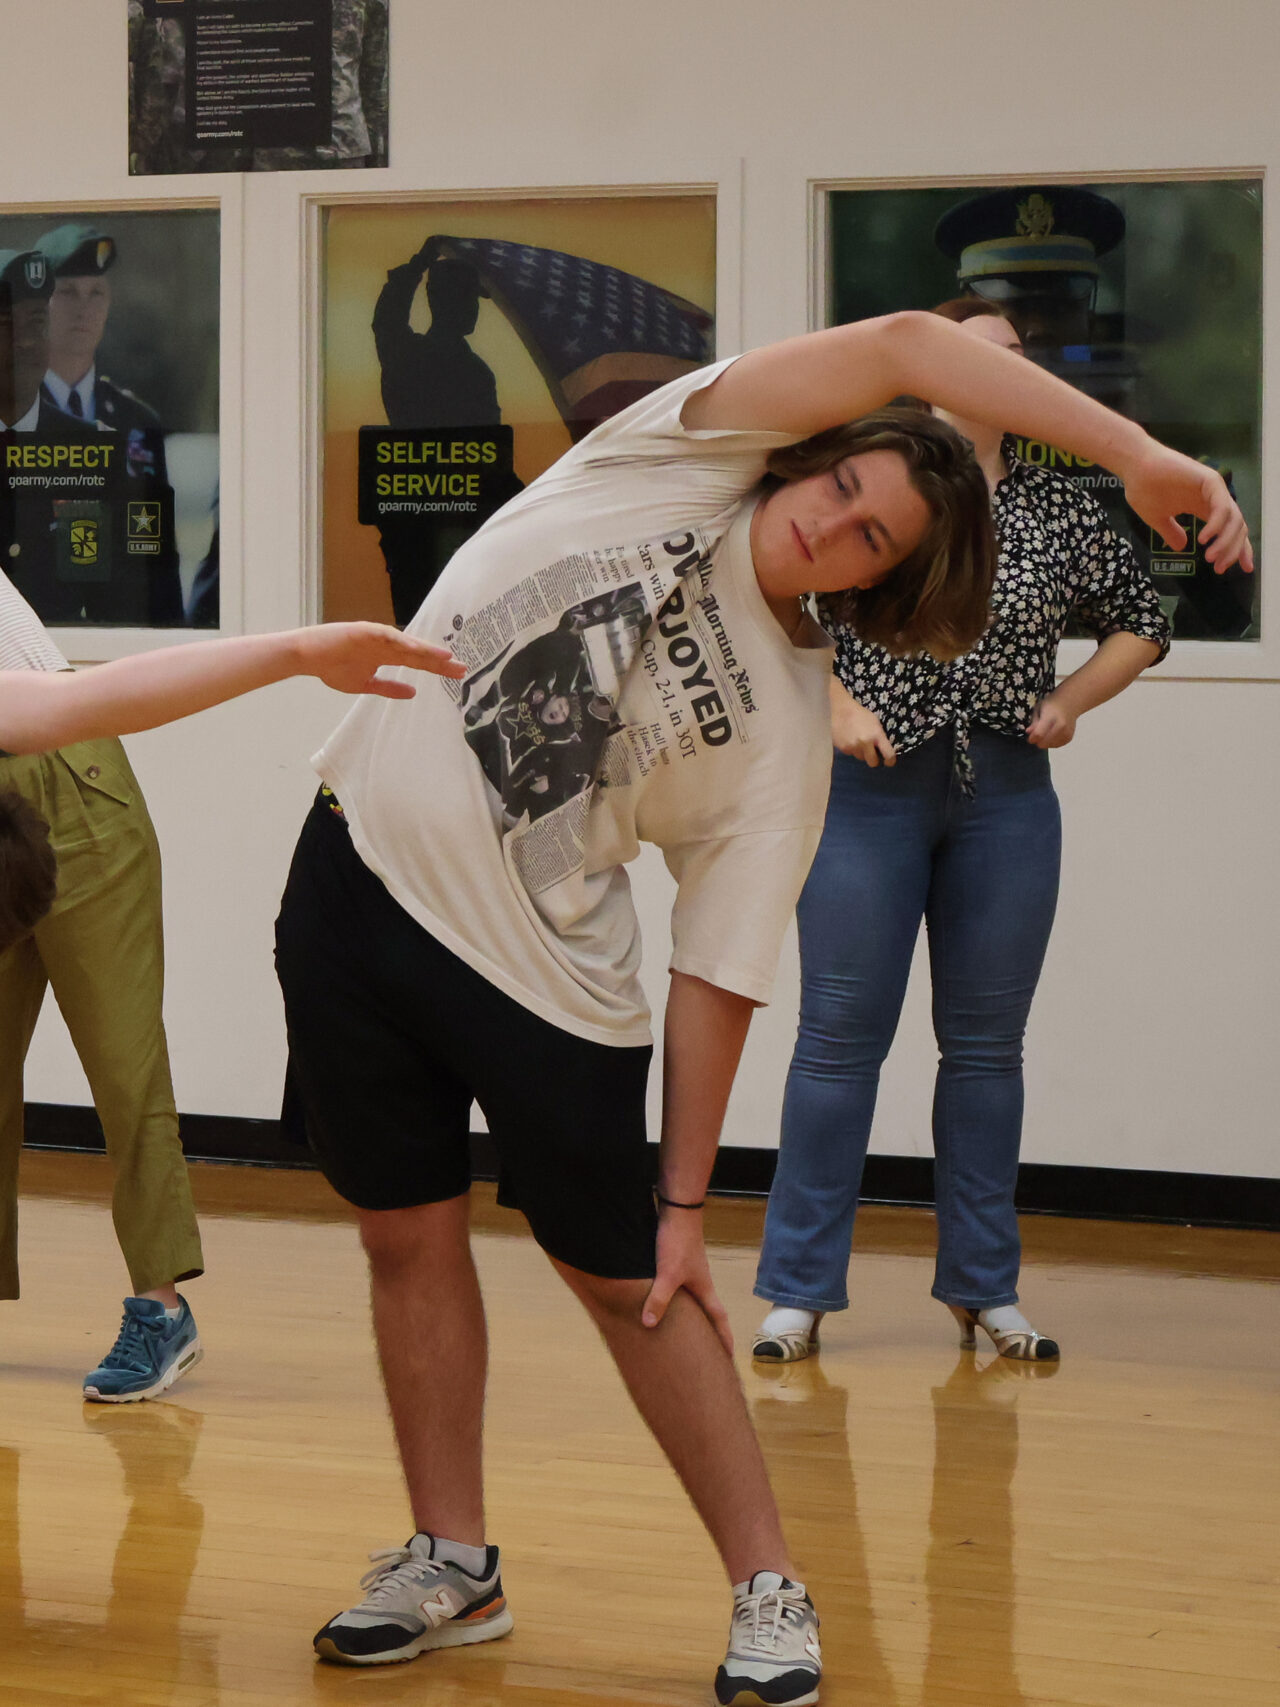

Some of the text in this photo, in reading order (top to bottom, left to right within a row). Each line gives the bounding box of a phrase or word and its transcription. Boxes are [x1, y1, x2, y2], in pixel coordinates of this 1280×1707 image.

[6, 445, 114, 468] RESPECT
[376, 441, 497, 464] SELFLESS
[8, 474, 105, 489] goarmy.com/rotc
[376, 474, 480, 496] SERVICE
[378, 501, 477, 514] goarmy.com/rotc
[650, 572, 666, 601] win
[640, 640, 658, 677] Cup,
[696, 593, 737, 670] Morning
[728, 668, 759, 714] News
[656, 678, 676, 708] 2-1,
[670, 710, 683, 727] in
[650, 722, 665, 745] Hull
[627, 729, 649, 777] the clutch
